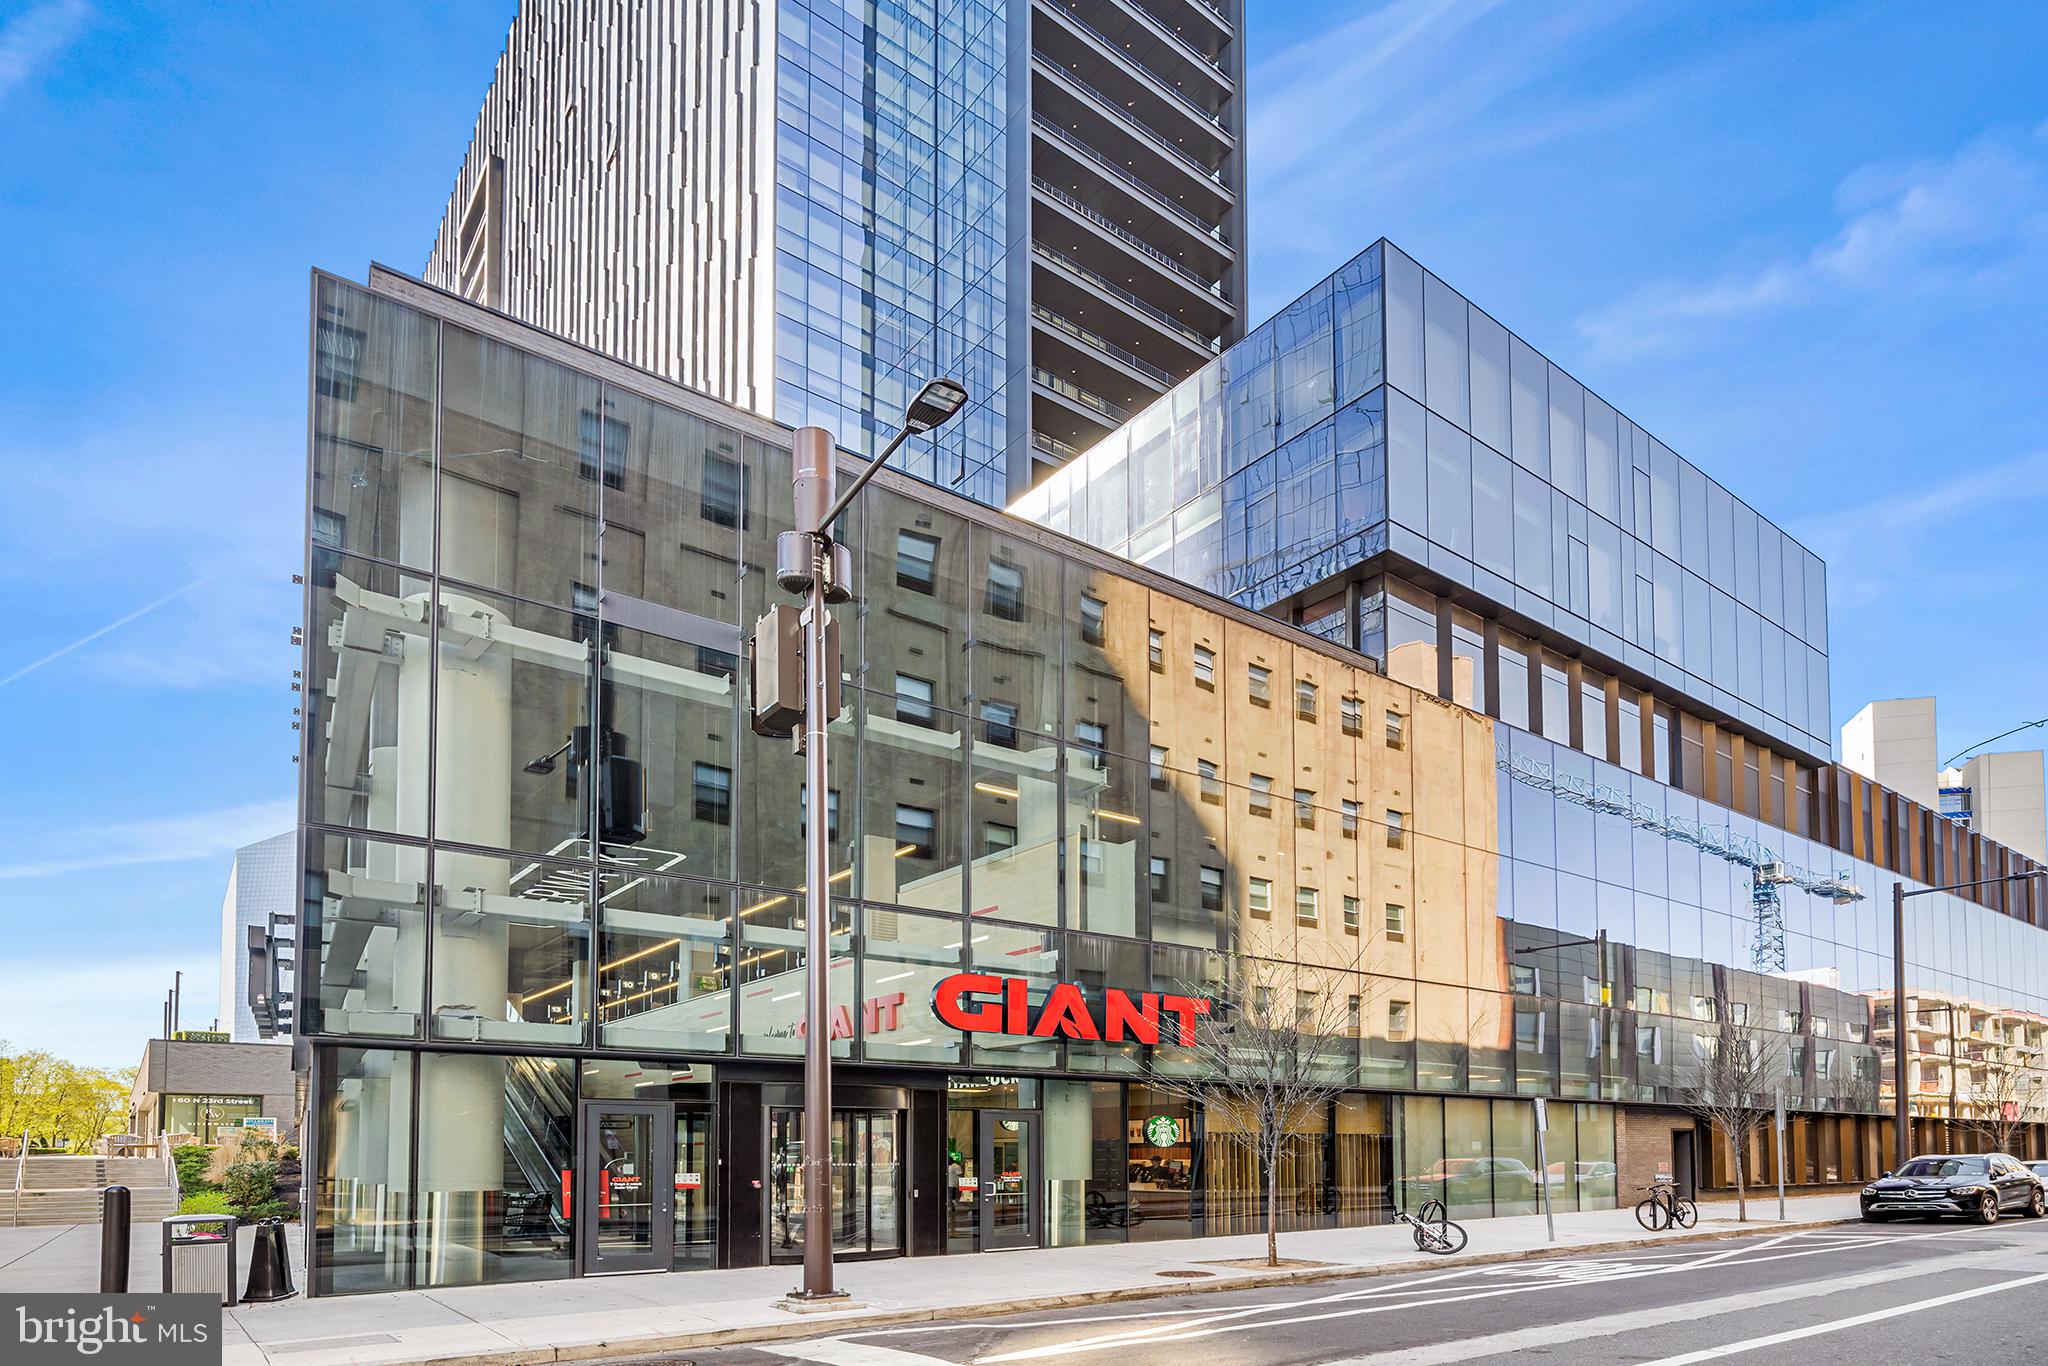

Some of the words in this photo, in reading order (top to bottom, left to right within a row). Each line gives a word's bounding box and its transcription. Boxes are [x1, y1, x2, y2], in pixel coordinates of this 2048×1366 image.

[797, 920, 805, 928] 5
[721, 946, 730, 954] 7
[930, 973, 1210, 1047] GIANT
[202, 1097, 224, 1105] 23rd
[226, 1097, 254, 1105] Street
